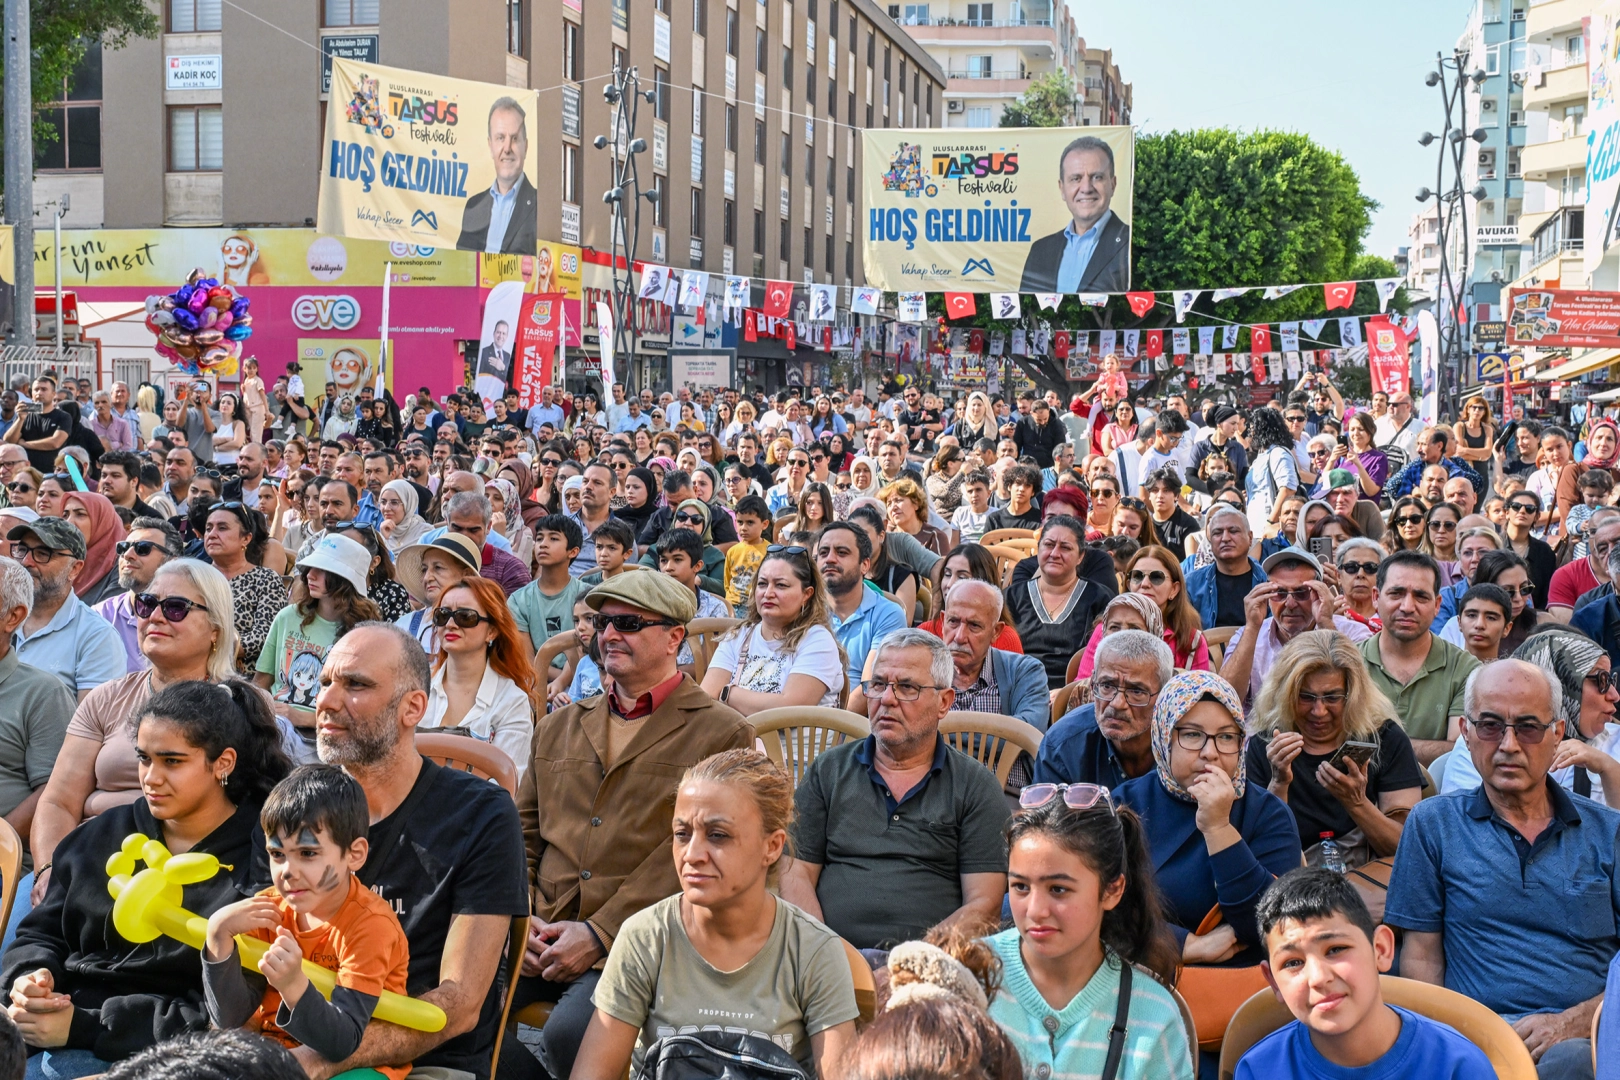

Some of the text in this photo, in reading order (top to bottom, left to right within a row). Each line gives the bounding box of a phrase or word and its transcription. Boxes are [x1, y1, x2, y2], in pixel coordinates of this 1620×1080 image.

[353, 48, 369, 56] TALAY
[356, 38, 371, 47] DURAN
[173, 68, 217, 81] KADİR KOÇ
[388, 83, 434, 97] ULUSLARARASI
[388, 91, 459, 127] TARSUS
[410, 120, 457, 146] Festivali
[329, 139, 469, 198] HOŞ GELDİNİZ
[931, 152, 1020, 179] TARSUS
[957, 176, 1018, 197] Festivali
[356, 206, 382, 227] Vahap
[869, 207, 918, 251] HOŞ
[925, 199, 1032, 242] GELDİNİZ
[901, 263, 928, 280] Vahap
[294, 298, 356, 329] eve
[523, 327, 554, 338] TARSUS
[698, 1008, 742, 1019] PROPERTY
